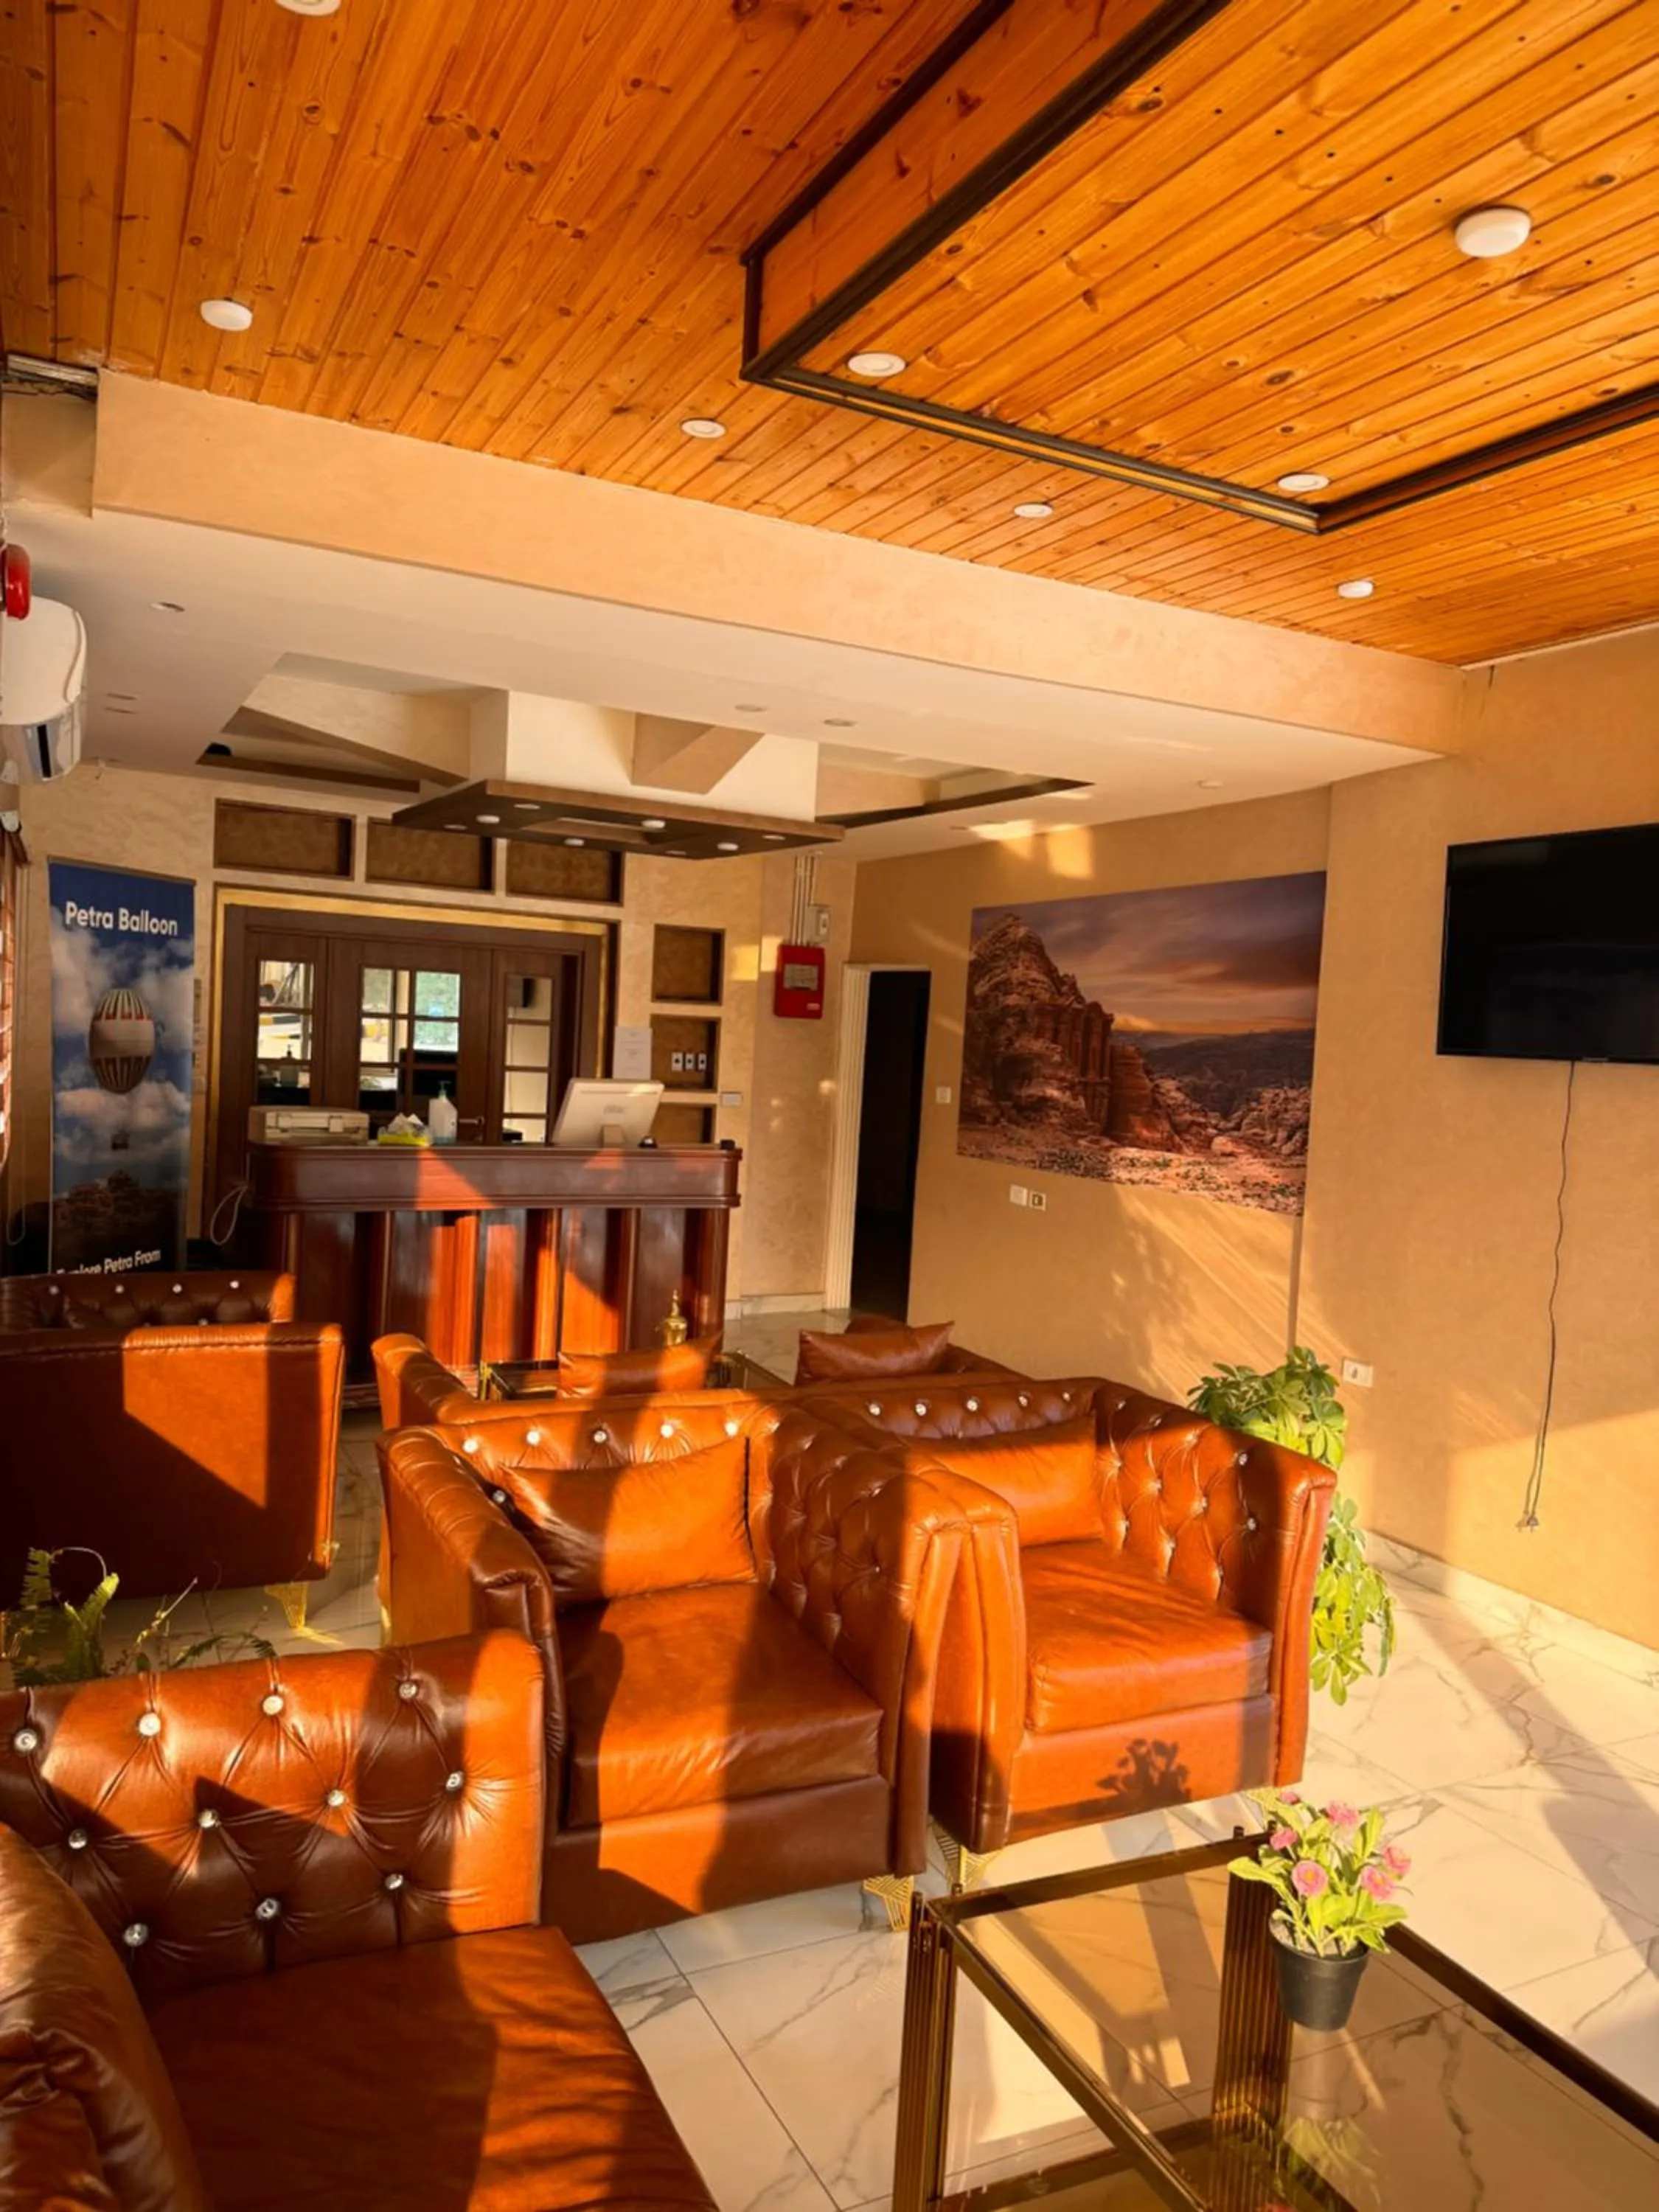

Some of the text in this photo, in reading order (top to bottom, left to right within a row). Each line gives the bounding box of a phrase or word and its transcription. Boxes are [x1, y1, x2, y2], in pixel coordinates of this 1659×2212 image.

[66, 900, 178, 935] Petra Balloon
[103, 1256, 133, 1274] Petra
[134, 1249, 161, 1267] From
